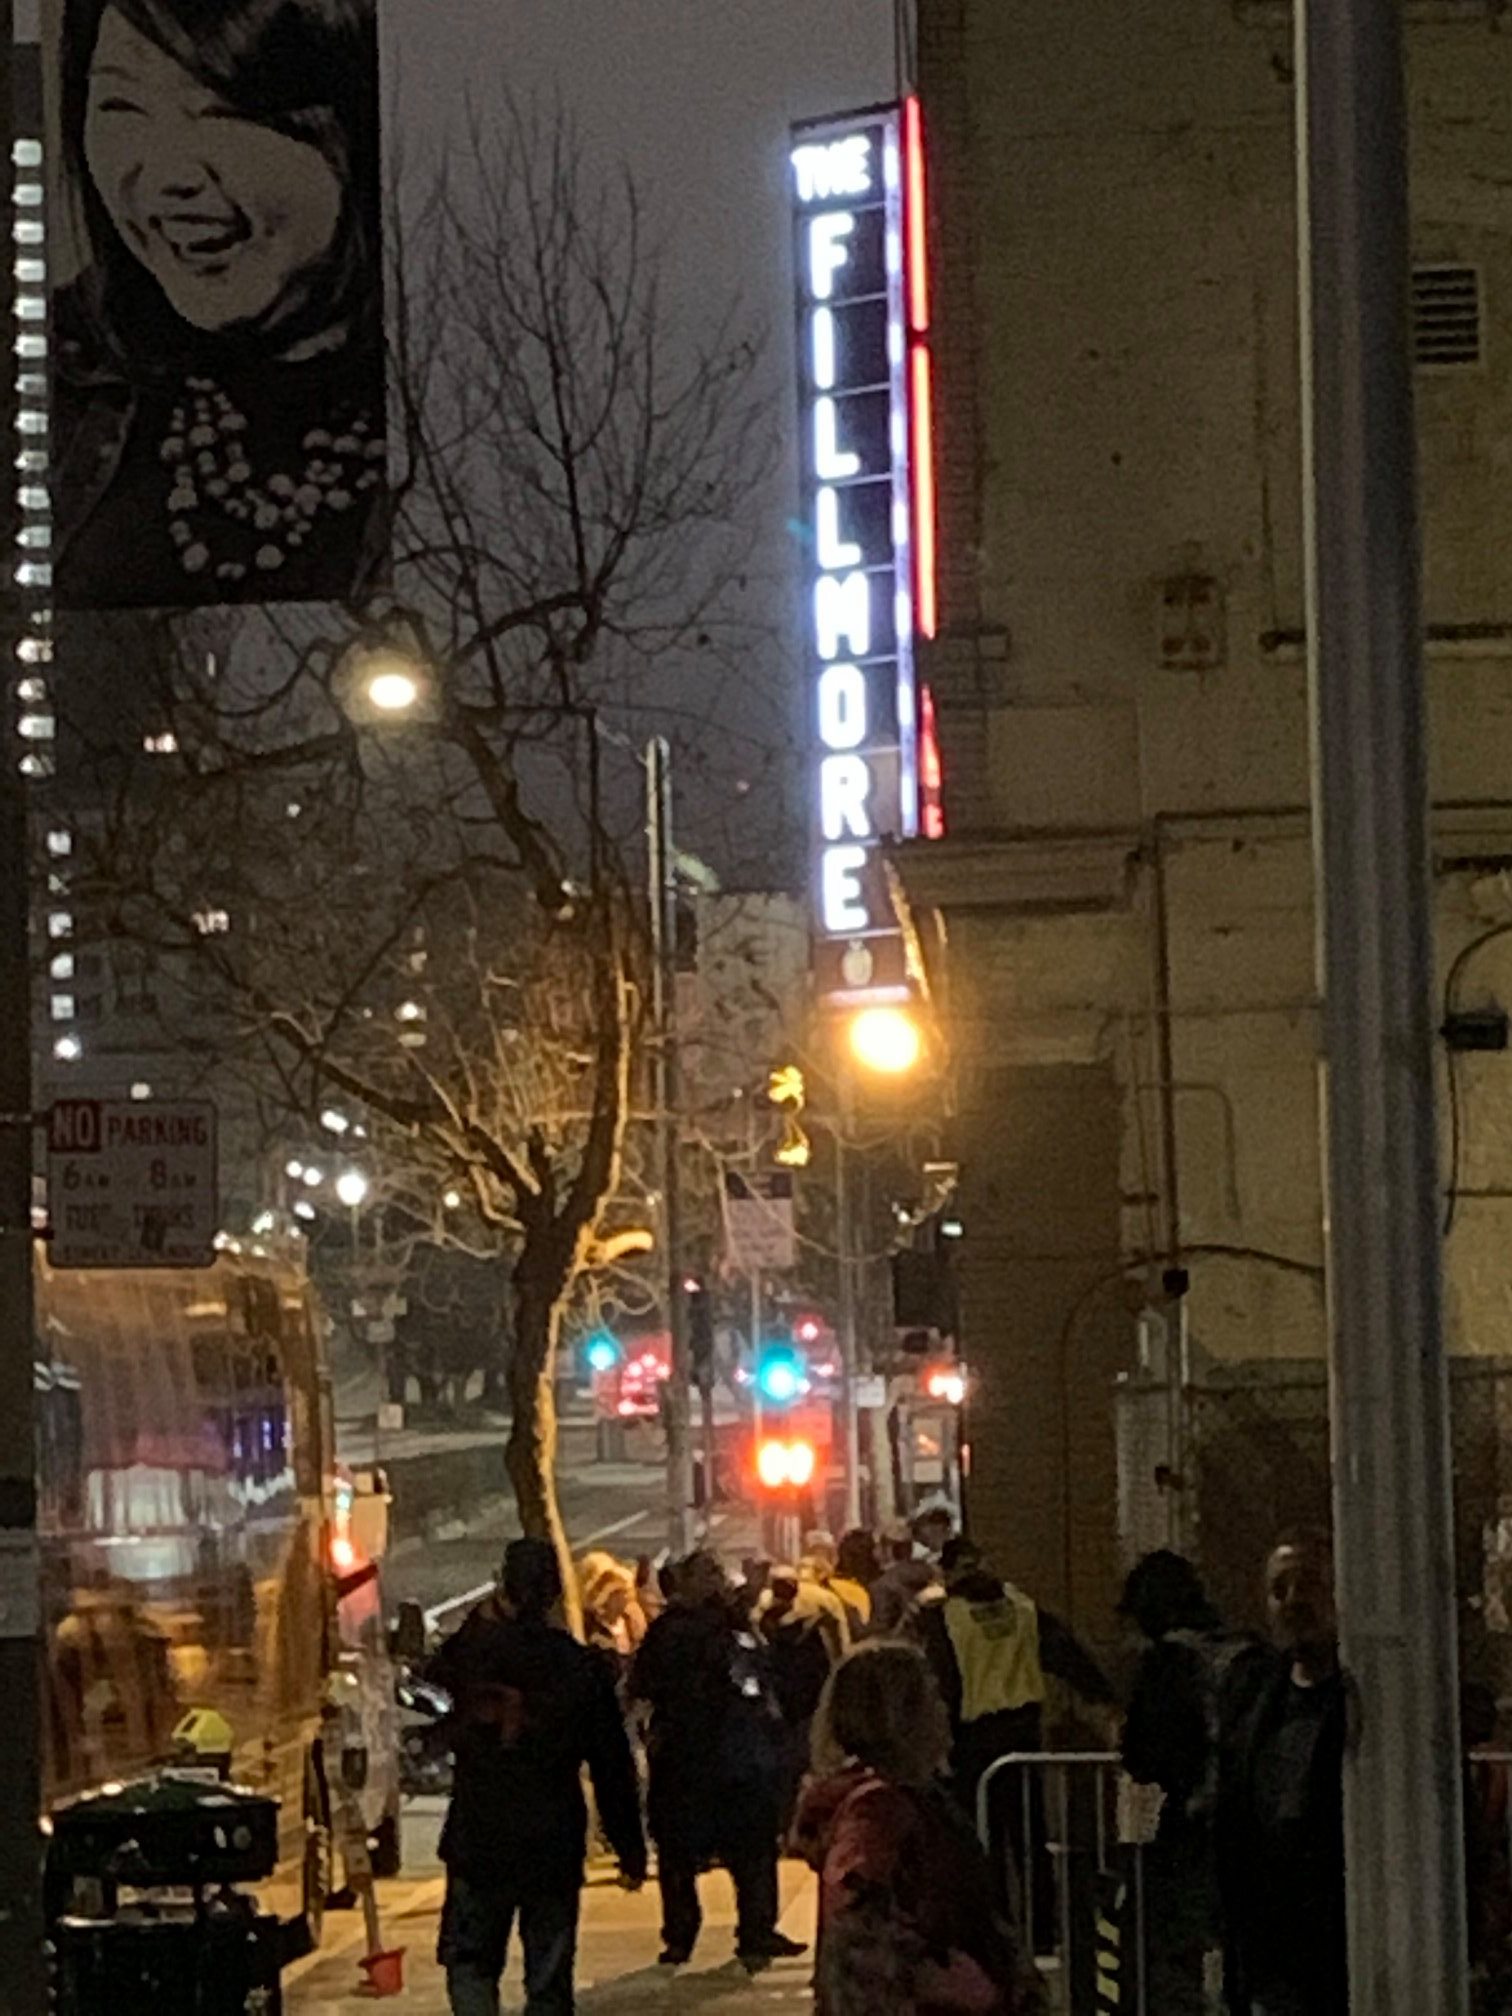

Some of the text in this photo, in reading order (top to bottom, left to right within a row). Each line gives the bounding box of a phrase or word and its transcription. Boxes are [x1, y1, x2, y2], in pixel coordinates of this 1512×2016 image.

[790, 134, 871, 202] THE
[809, 212, 871, 931] FILLMORE
[52, 1104, 208, 1148] NO PARKING
